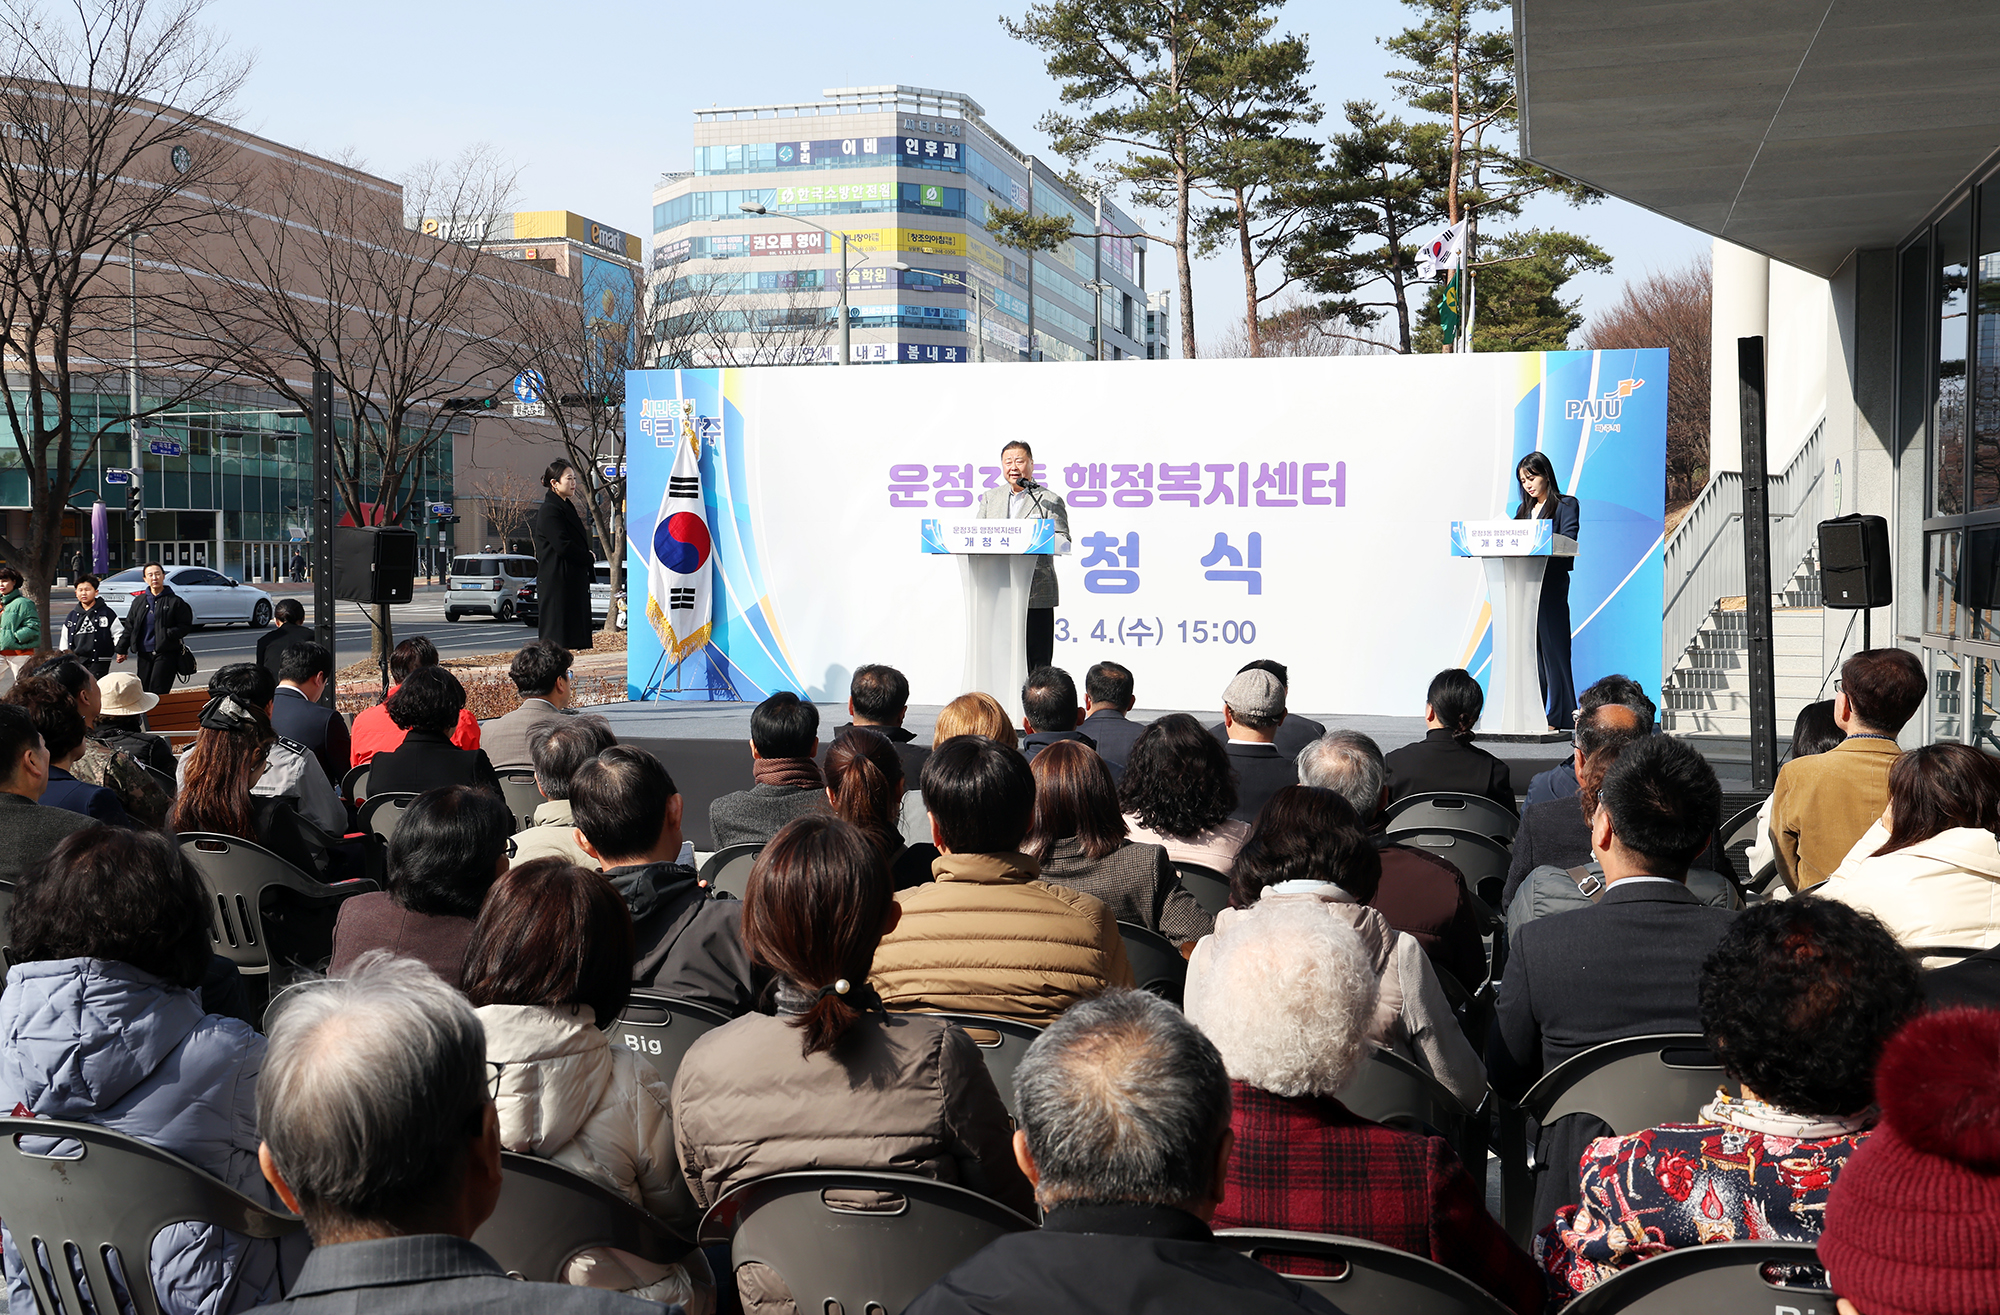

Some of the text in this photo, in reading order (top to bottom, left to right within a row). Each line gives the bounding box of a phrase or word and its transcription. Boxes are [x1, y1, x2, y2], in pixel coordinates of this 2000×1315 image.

[797, 183, 891, 202] 한국소방안전원
[591, 223, 622, 252] emart
[796, 233, 822, 248] 영어
[907, 344, 958, 362] 봄내과
[1566, 399, 1622, 422] PAJU
[888, 461, 1347, 508] 운정3 행정복지센터
[952, 526, 1022, 535] 운정3동 행정복지센터
[1177, 619, 1256, 644] 15:00
[624, 1034, 663, 1055] Big
